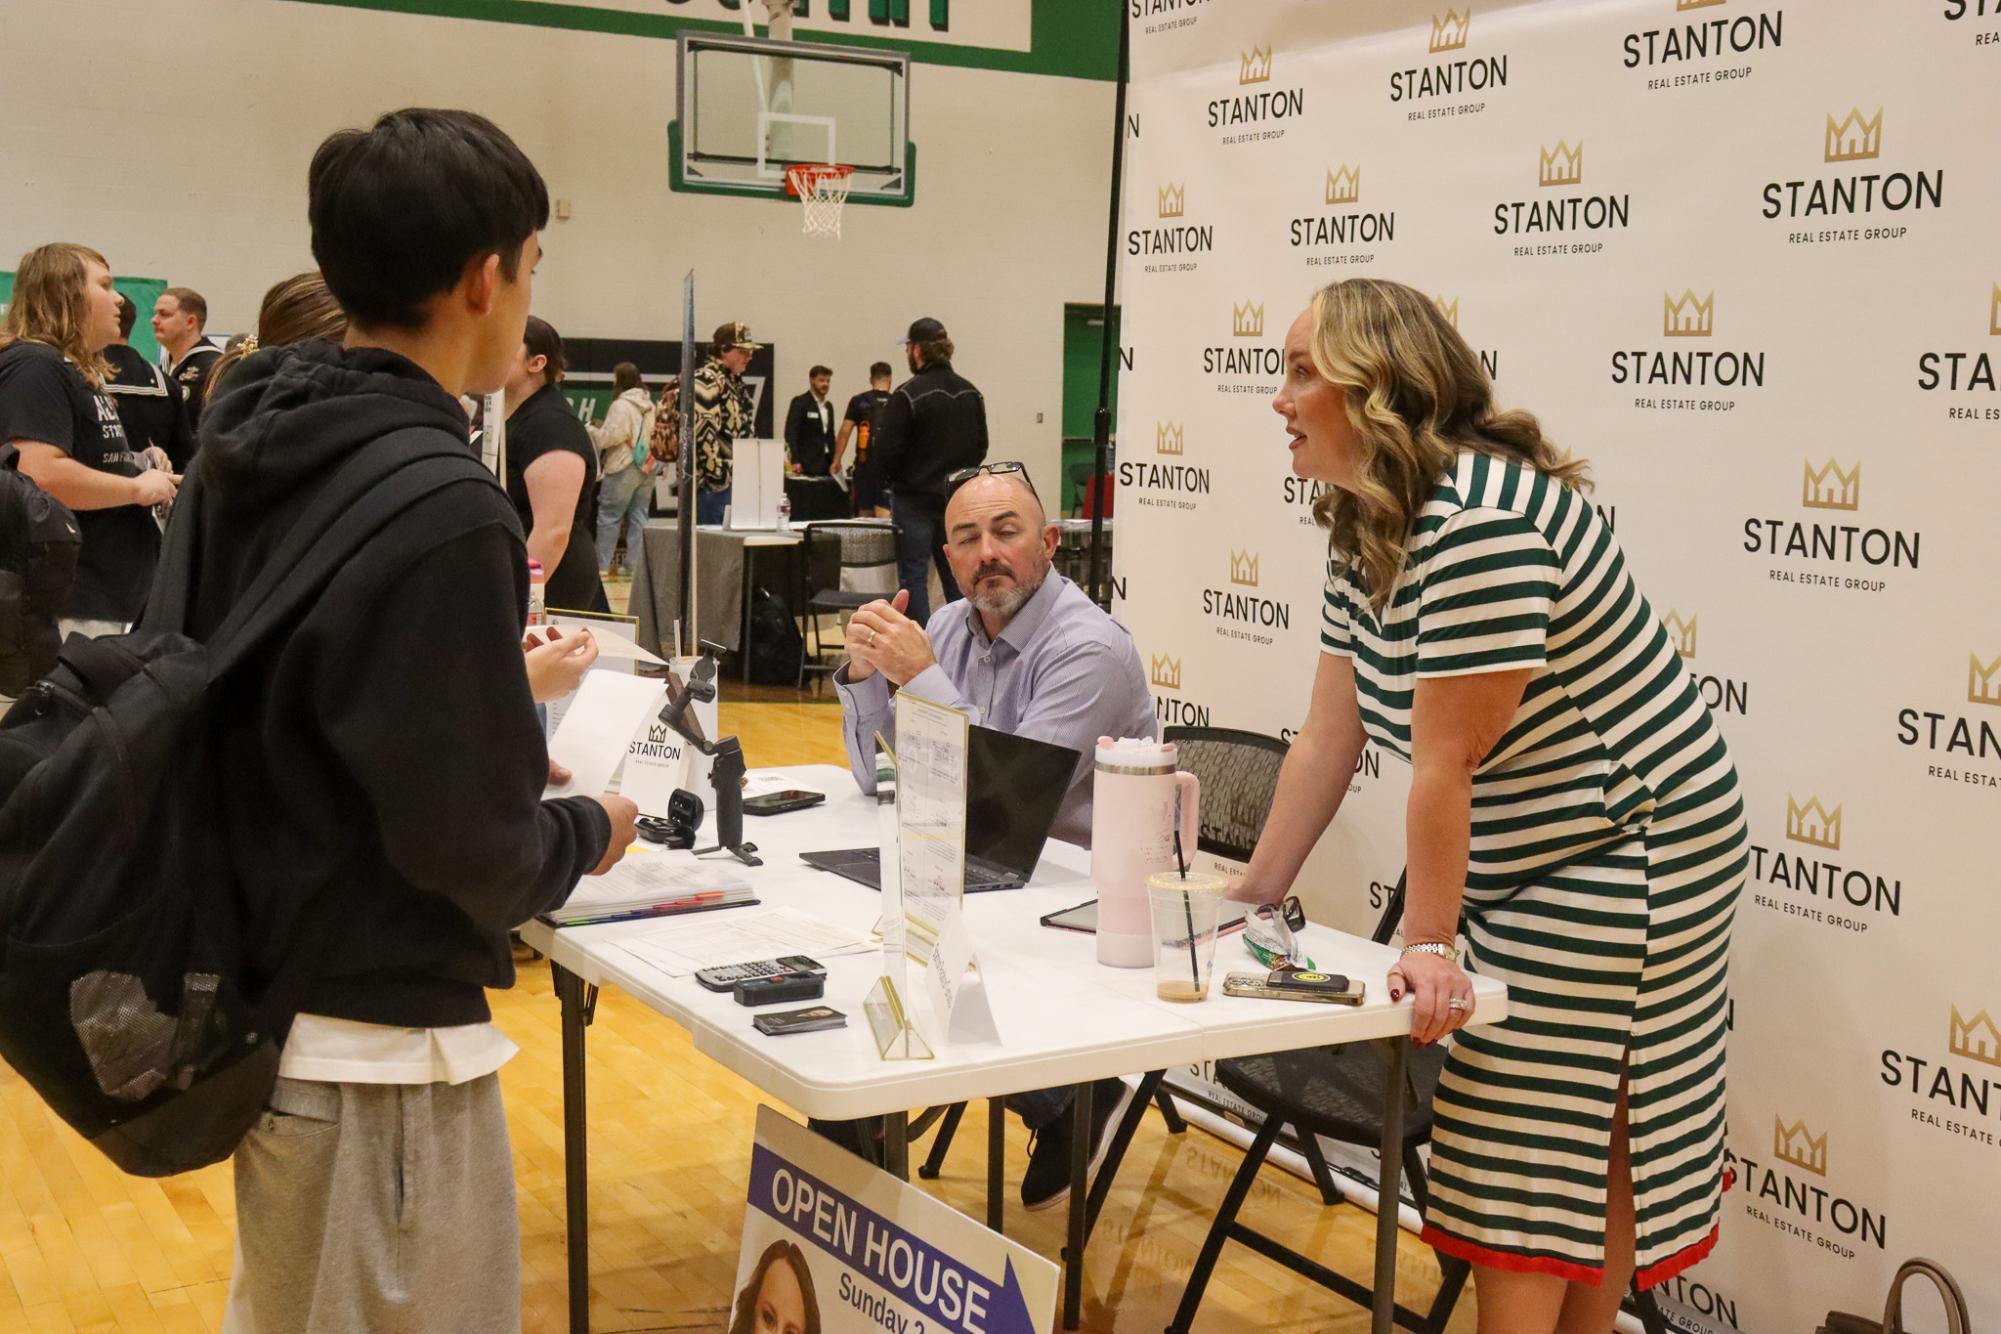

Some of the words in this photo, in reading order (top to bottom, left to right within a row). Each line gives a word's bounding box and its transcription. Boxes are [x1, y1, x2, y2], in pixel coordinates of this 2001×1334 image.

[1624, 11, 1782, 68] STANTON
[1391, 55, 1506, 102] STANTON
[1647, 78, 1671, 90] REAL
[1674, 71, 1711, 87] ESTATE
[1714, 66, 1752, 82] GROUP
[1209, 88, 1302, 128] STANTON
[1408, 111, 1425, 121] REAL
[1427, 106, 1455, 119] ESTATE
[1457, 102, 1486, 115] GROUP
[1222, 136, 1237, 145] REAL
[1238, 132, 1260, 144] ESTATE
[1262, 129, 1285, 141] GROUP
[1763, 170, 1942, 218] STANTON
[1291, 212, 1394, 246] STANTON
[1495, 195, 1628, 234] STANTON
[1129, 226, 1212, 255] STANTON
[1514, 246, 1534, 257] REAL
[1536, 244, 1568, 256] ESTATE
[1571, 242, 1603, 254] GROUP
[1789, 232, 1814, 244] REAL
[1819, 229, 1859, 243] ESTATE
[1864, 226, 1907, 240] GROUP
[1144, 265, 1158, 273] REAL
[1158, 263, 1178, 273] ESTATE
[1178, 263, 1198, 272] GROUP
[1306, 257, 1322, 266] REAL
[1323, 255, 1348, 265] ESTATE
[1349, 254, 1375, 264] GROUP
[1612, 351, 1764, 386] STANTON
[1217, 384, 1231, 393] REAL
[1232, 384, 1254, 394] ESTATE
[1256, 385, 1278, 395] GROUP
[1635, 398, 1657, 409] REAL
[1661, 399, 1696, 411] ESTATE
[1699, 400, 1735, 412] GROUP
[1949, 408, 1979, 419] REAL
[1120, 463, 1209, 493] STANTON
[1138, 497, 1155, 507] REAL
[1156, 498, 1177, 509] ESTATE
[1177, 501, 1197, 511] GROUP
[1744, 518, 1919, 569] STANTON
[1769, 569, 1795, 583] REAL
[1799, 572, 1840, 588] ESTATE
[1844, 577, 1886, 592] GROUP
[1204, 589, 1288, 630] STANTON
[1216, 626, 1229, 637] REAL
[1230, 629, 1251, 642] ESTATE
[1252, 634, 1273, 646] GROUP
[629, 741, 681, 761] STANTON
[1928, 766, 1958, 781] REAL
[1964, 772, 2001, 787] ESTA
[1751, 846, 1900, 917] TANTON
[1754, 894, 1779, 911] REAL
[1783, 902, 1822, 923] ESTATE
[1827, 914, 1868, 933] GROUP
[1911, 1108, 1941, 1128] REAL
[1946, 1120, 1993, 1145] ESTATE
[1746, 1205, 1771, 1225] REAL
[1774, 1217, 1812, 1243] ESTATE
[1816, 1236, 1856, 1260] GROUP
[772, 1168, 857, 1256] OPEN
[863, 1220, 990, 1334] HOUSE
[839, 1272, 908, 1334] Sunday
